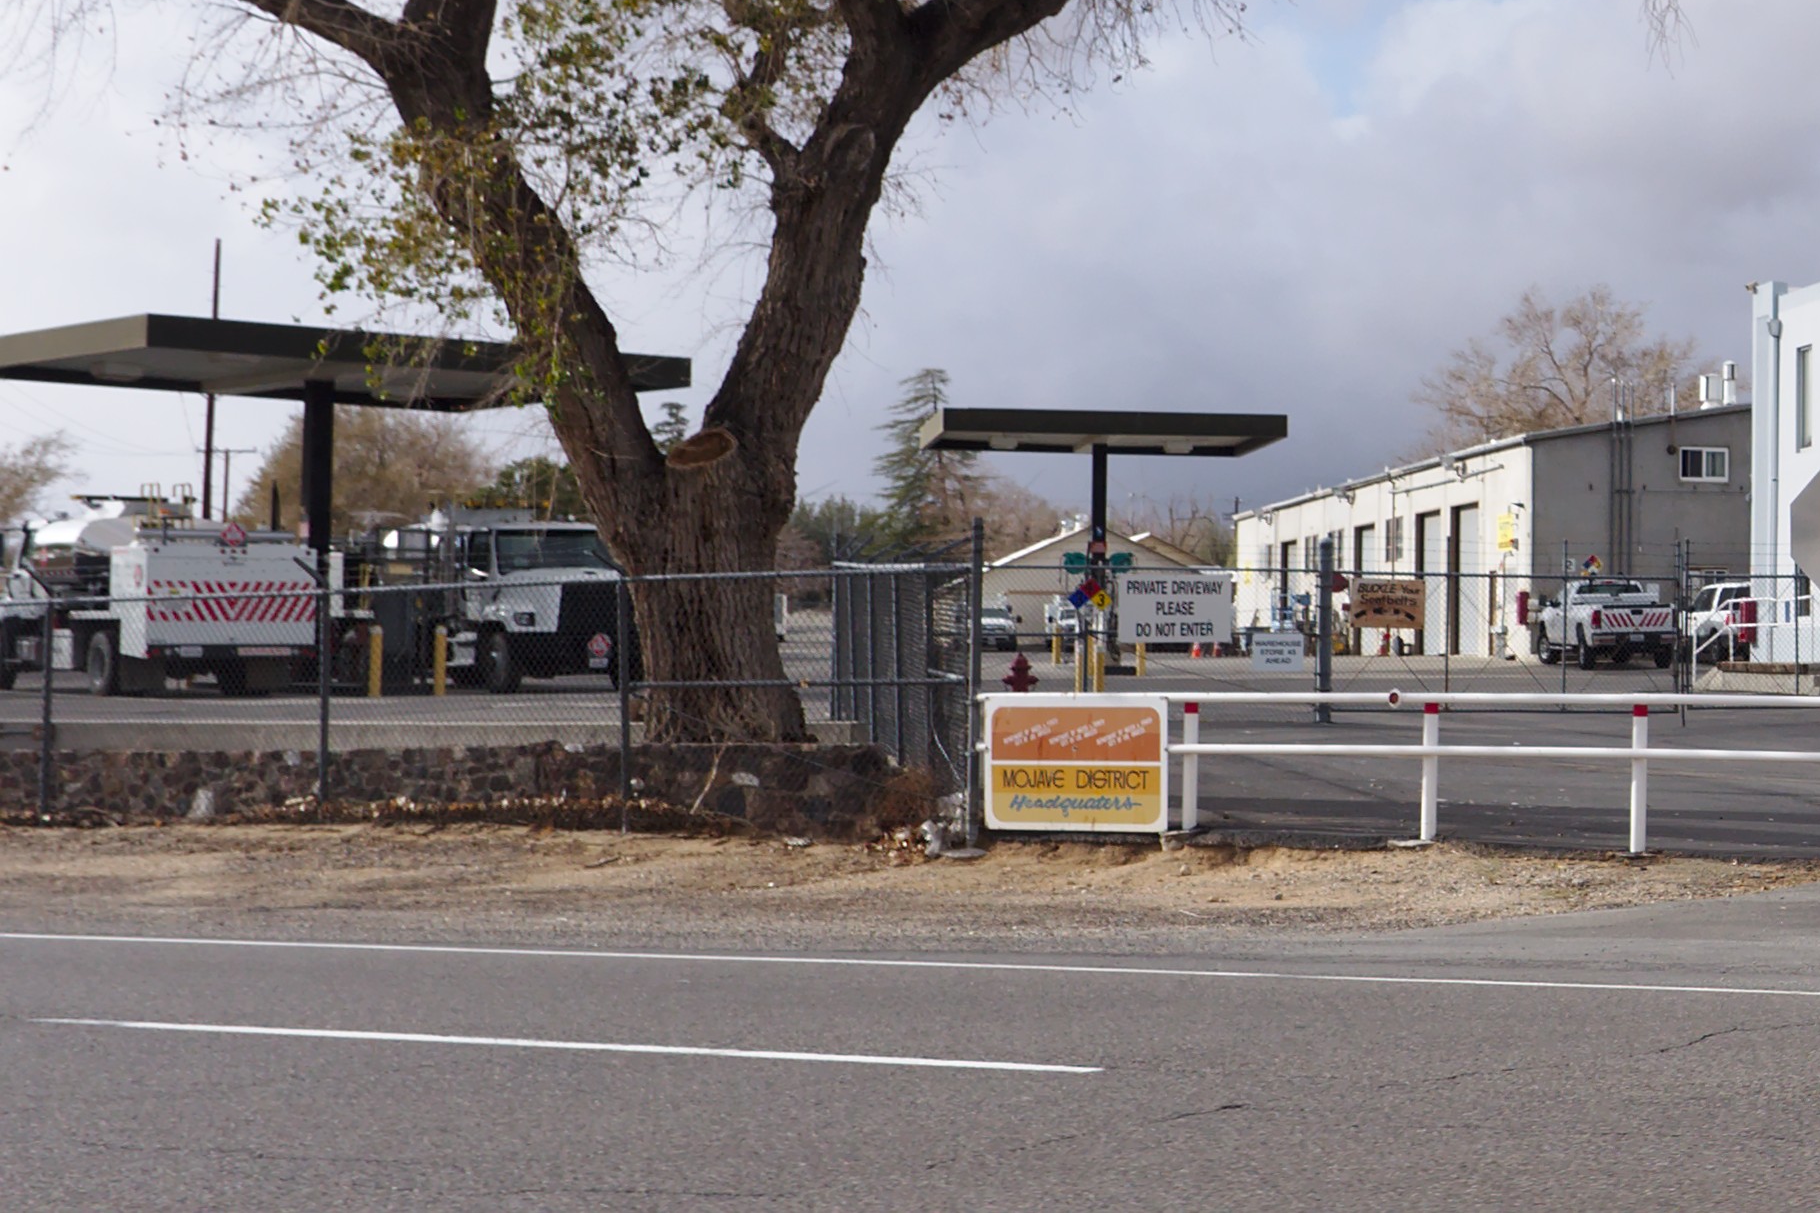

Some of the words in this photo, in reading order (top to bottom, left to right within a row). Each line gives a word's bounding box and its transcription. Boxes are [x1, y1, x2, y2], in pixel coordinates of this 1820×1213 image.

[1127, 580, 1168, 595] PRIVATE
[1171, 580, 1223, 595] DRIVEWAY
[1358, 583, 1396, 594] BUCKLE
[1097, 593, 1105, 607] 3
[1156, 601, 1195, 616] PLEASE
[1136, 622, 1152, 637] DO
[1155, 623, 1176, 637] NOT
[1180, 622, 1214, 637] ENTER
[1003, 769, 1065, 789] MOJAVE
[1075, 769, 1149, 789] DISTRICT
